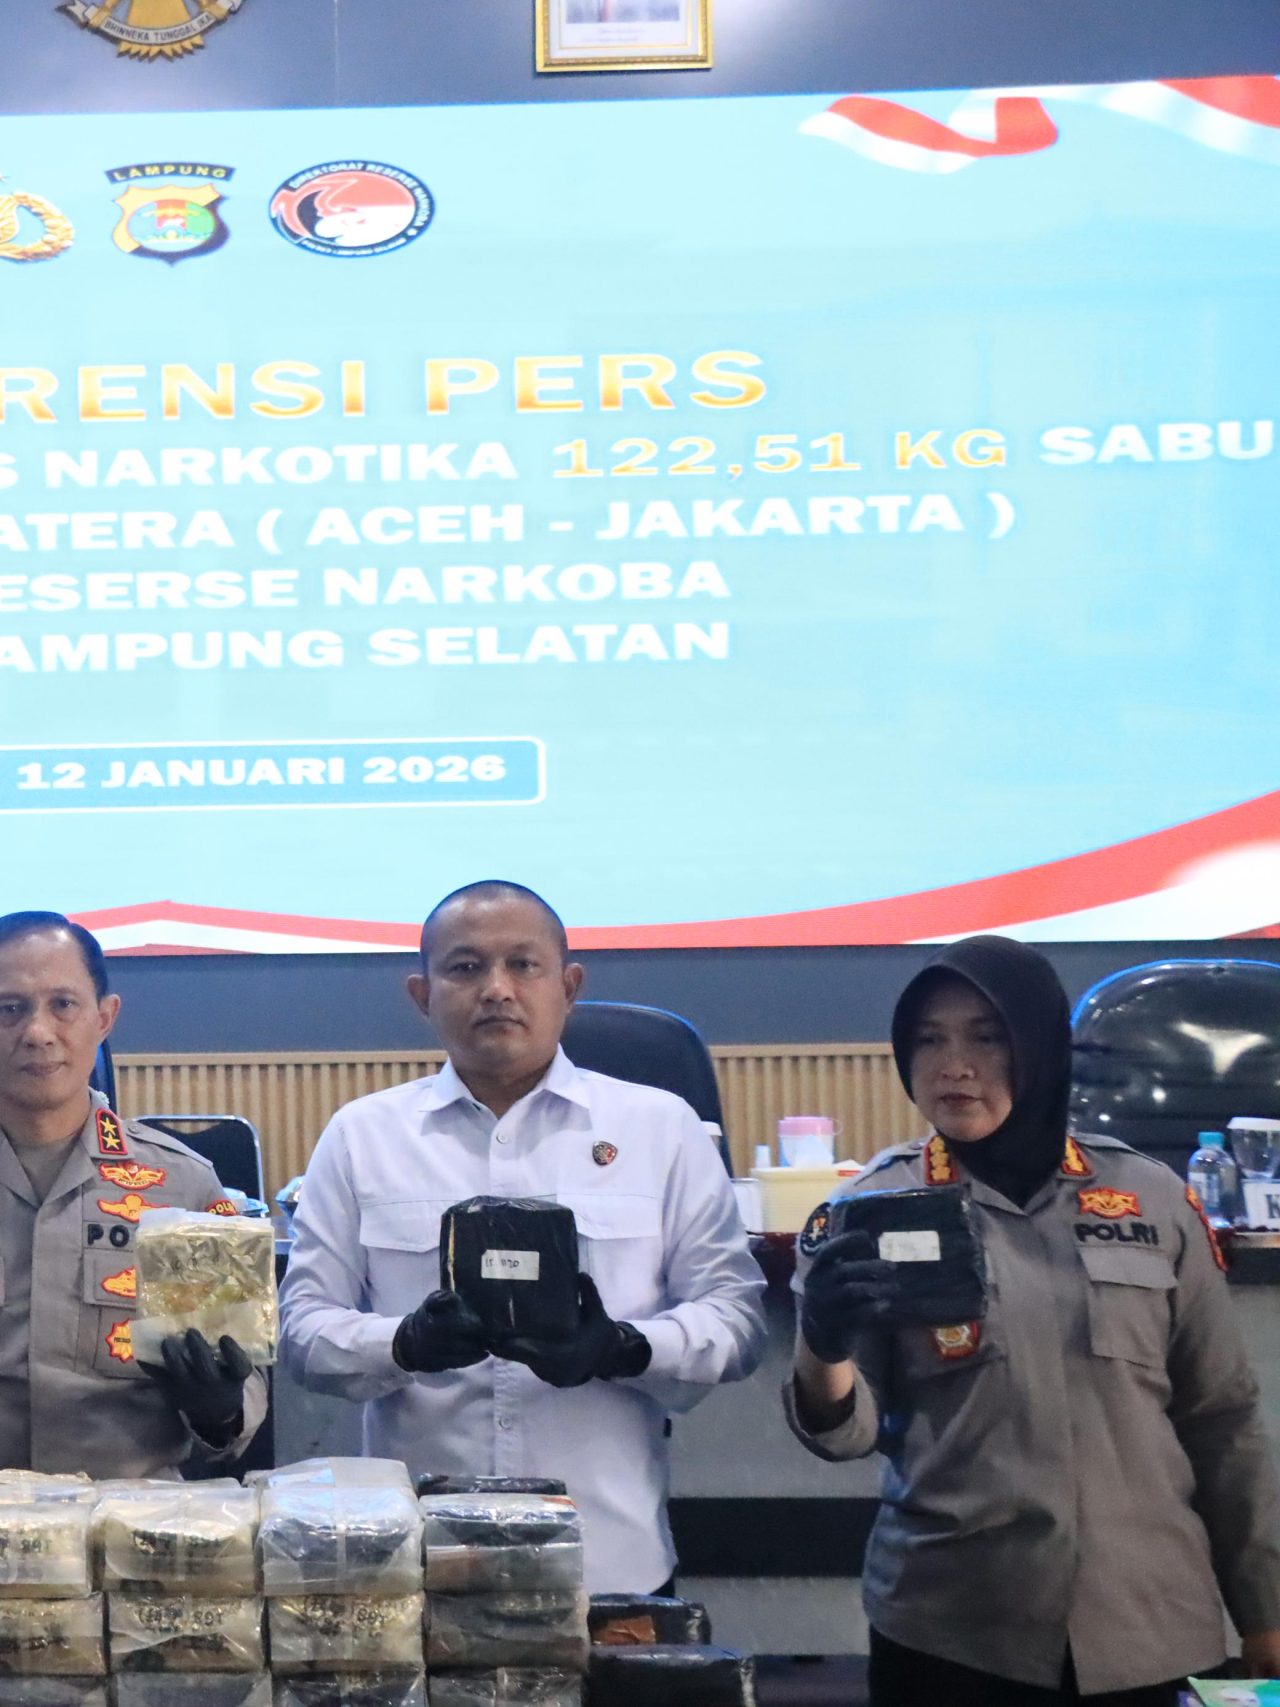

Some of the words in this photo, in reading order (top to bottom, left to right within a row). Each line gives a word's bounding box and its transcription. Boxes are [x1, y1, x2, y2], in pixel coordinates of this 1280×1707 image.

[104, 20, 150, 41] BHINNEKA
[154, 24, 197, 41] TUNGGAL
[113, 164, 226, 181] LAMPUNG
[426, 352, 767, 416] PERS
[46, 443, 518, 488] NARKOTIKA
[554, 434, 862, 480] 122,51
[897, 430, 1007, 470] KG
[1043, 422, 1273, 465] SABU
[308, 505, 524, 546] ACEH
[598, 496, 963, 540] JAKARTA
[325, 562, 730, 606] NARKOBA
[370, 623, 728, 666] SELATAN
[20, 764, 86, 790] 12
[103, 759, 345, 788] JANUARI
[365, 756, 506, 784] 2026
[1074, 1222, 1160, 1246] POLRI
